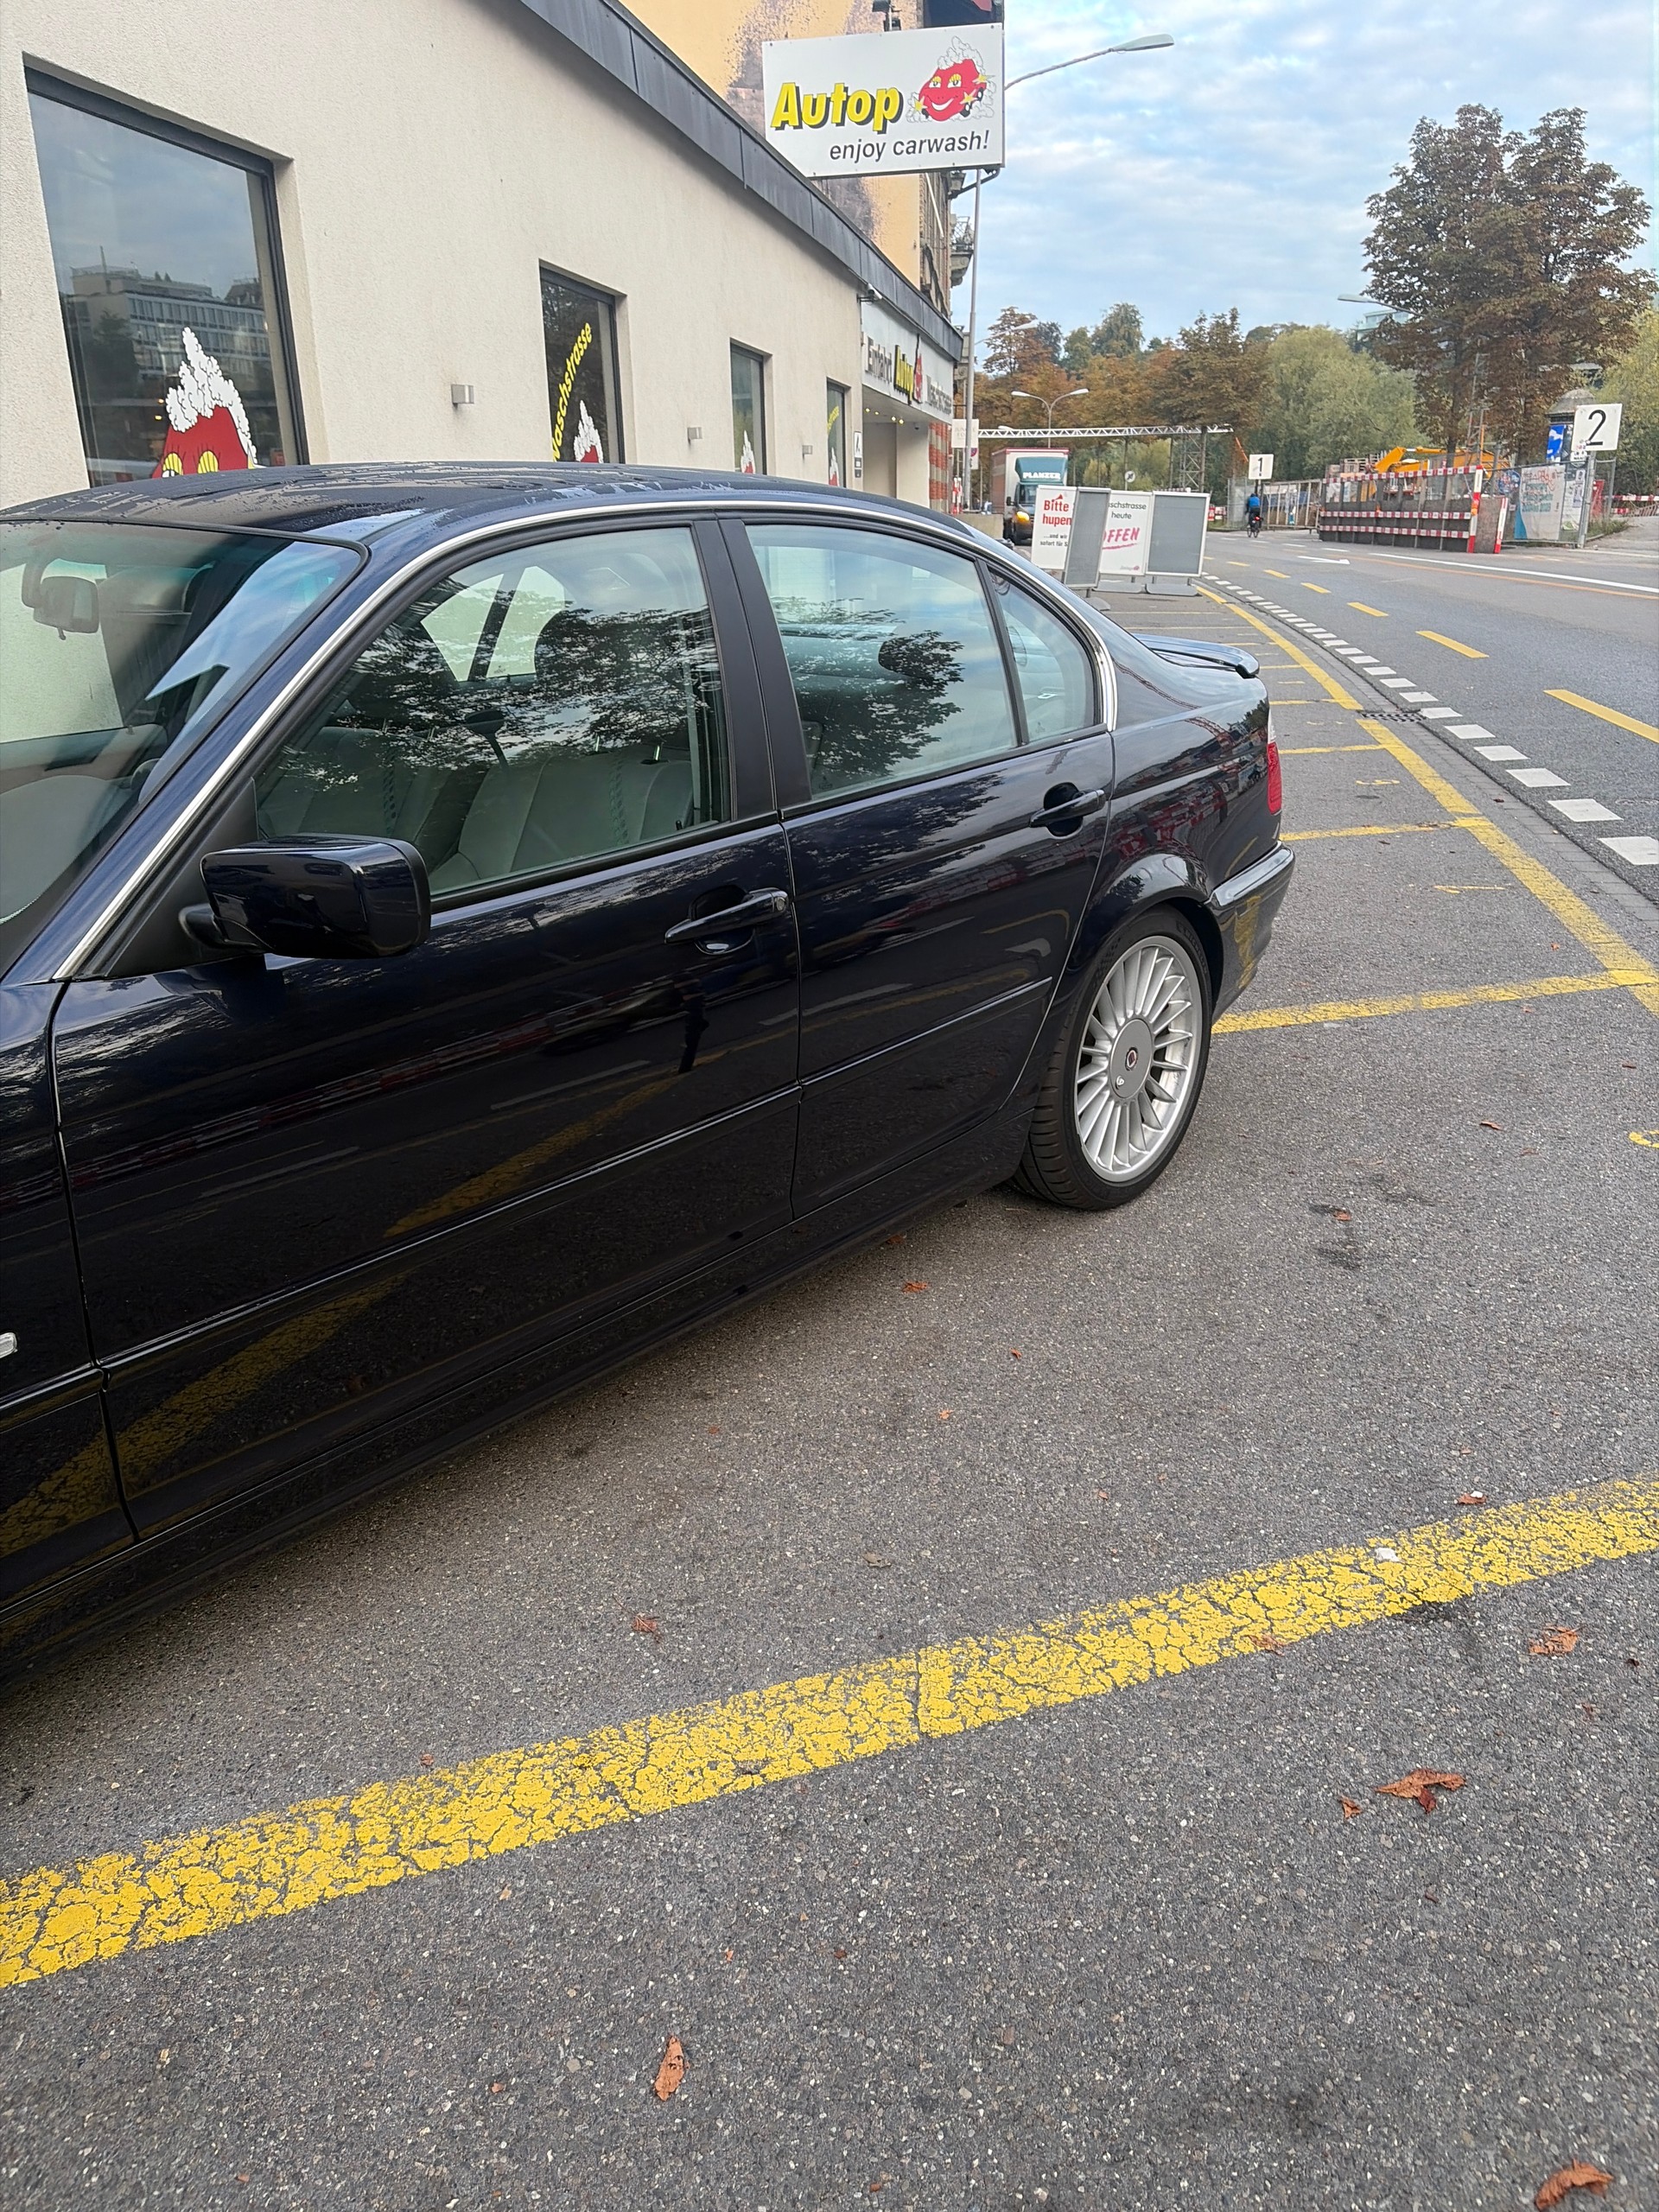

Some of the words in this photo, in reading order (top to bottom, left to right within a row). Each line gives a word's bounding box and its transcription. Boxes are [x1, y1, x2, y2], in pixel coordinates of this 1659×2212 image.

[771, 82, 904, 134] Autop
[830, 138, 887, 163] enjoy
[893, 130, 990, 156] carwash!
[1586, 409, 1606, 446] 2
[1044, 499, 1070, 512] Bitte
[1108, 501, 1147, 510] schstrasse
[1042, 513, 1072, 527] hupen
[1111, 511, 1132, 519] heute
